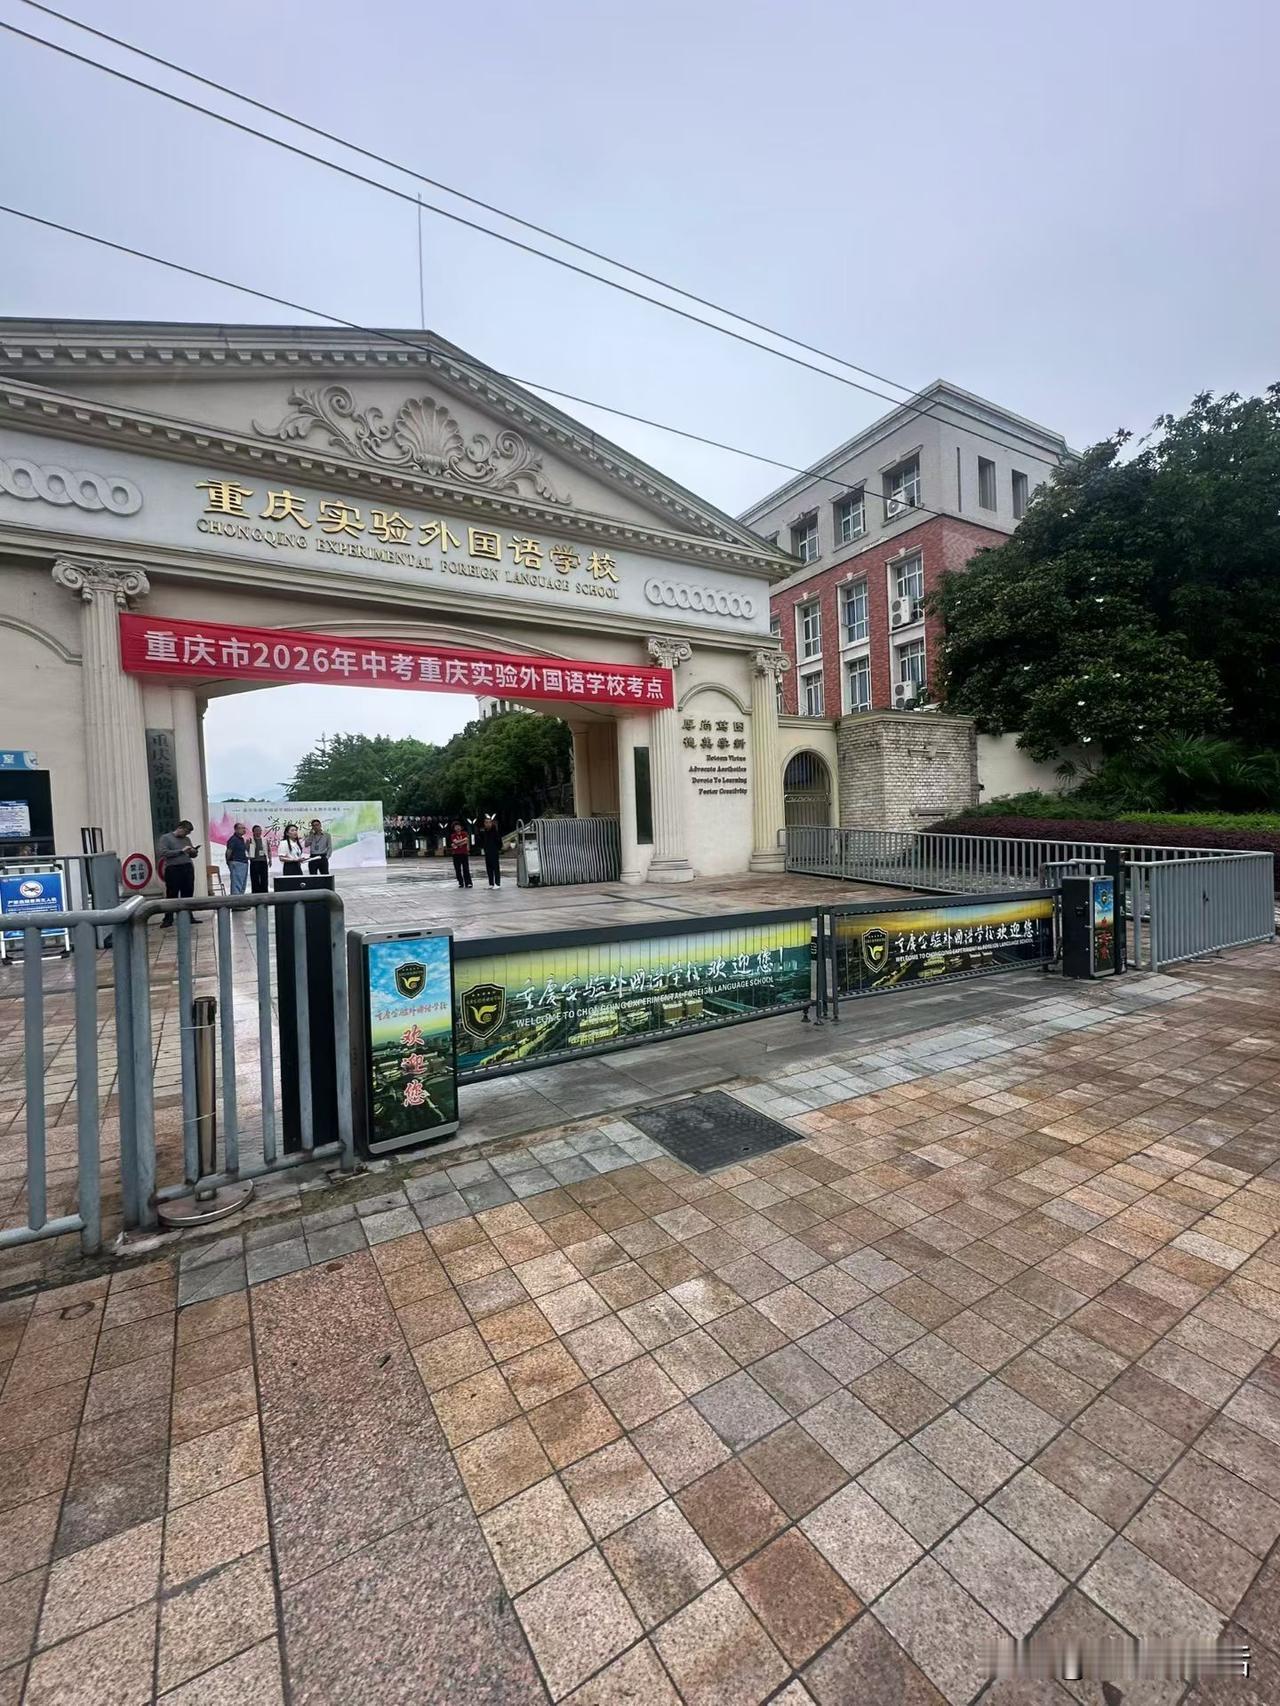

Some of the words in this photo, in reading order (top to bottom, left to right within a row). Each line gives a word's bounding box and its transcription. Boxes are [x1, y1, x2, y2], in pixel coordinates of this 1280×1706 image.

[195, 478, 620, 583] 重庆实验外国语学校
[197, 518, 308, 549] CHONGQING
[315, 537, 433, 571] EXPERIMENTAL
[440, 560, 499, 583] FOREIGN
[505, 570, 570, 592] LANGUAGE
[575, 583, 620, 599] SCHOOL
[144, 629, 664, 700] 重庆市2026年中考重庆实验外国语学校考点
[516, 1013, 562, 1028] WELCOME
[562, 1010, 575, 1019] TO
[685, 985, 714, 999] FOREIGN
[714, 980, 750, 993] LANGUAGE
[750, 976, 774, 987] SCHOOL
